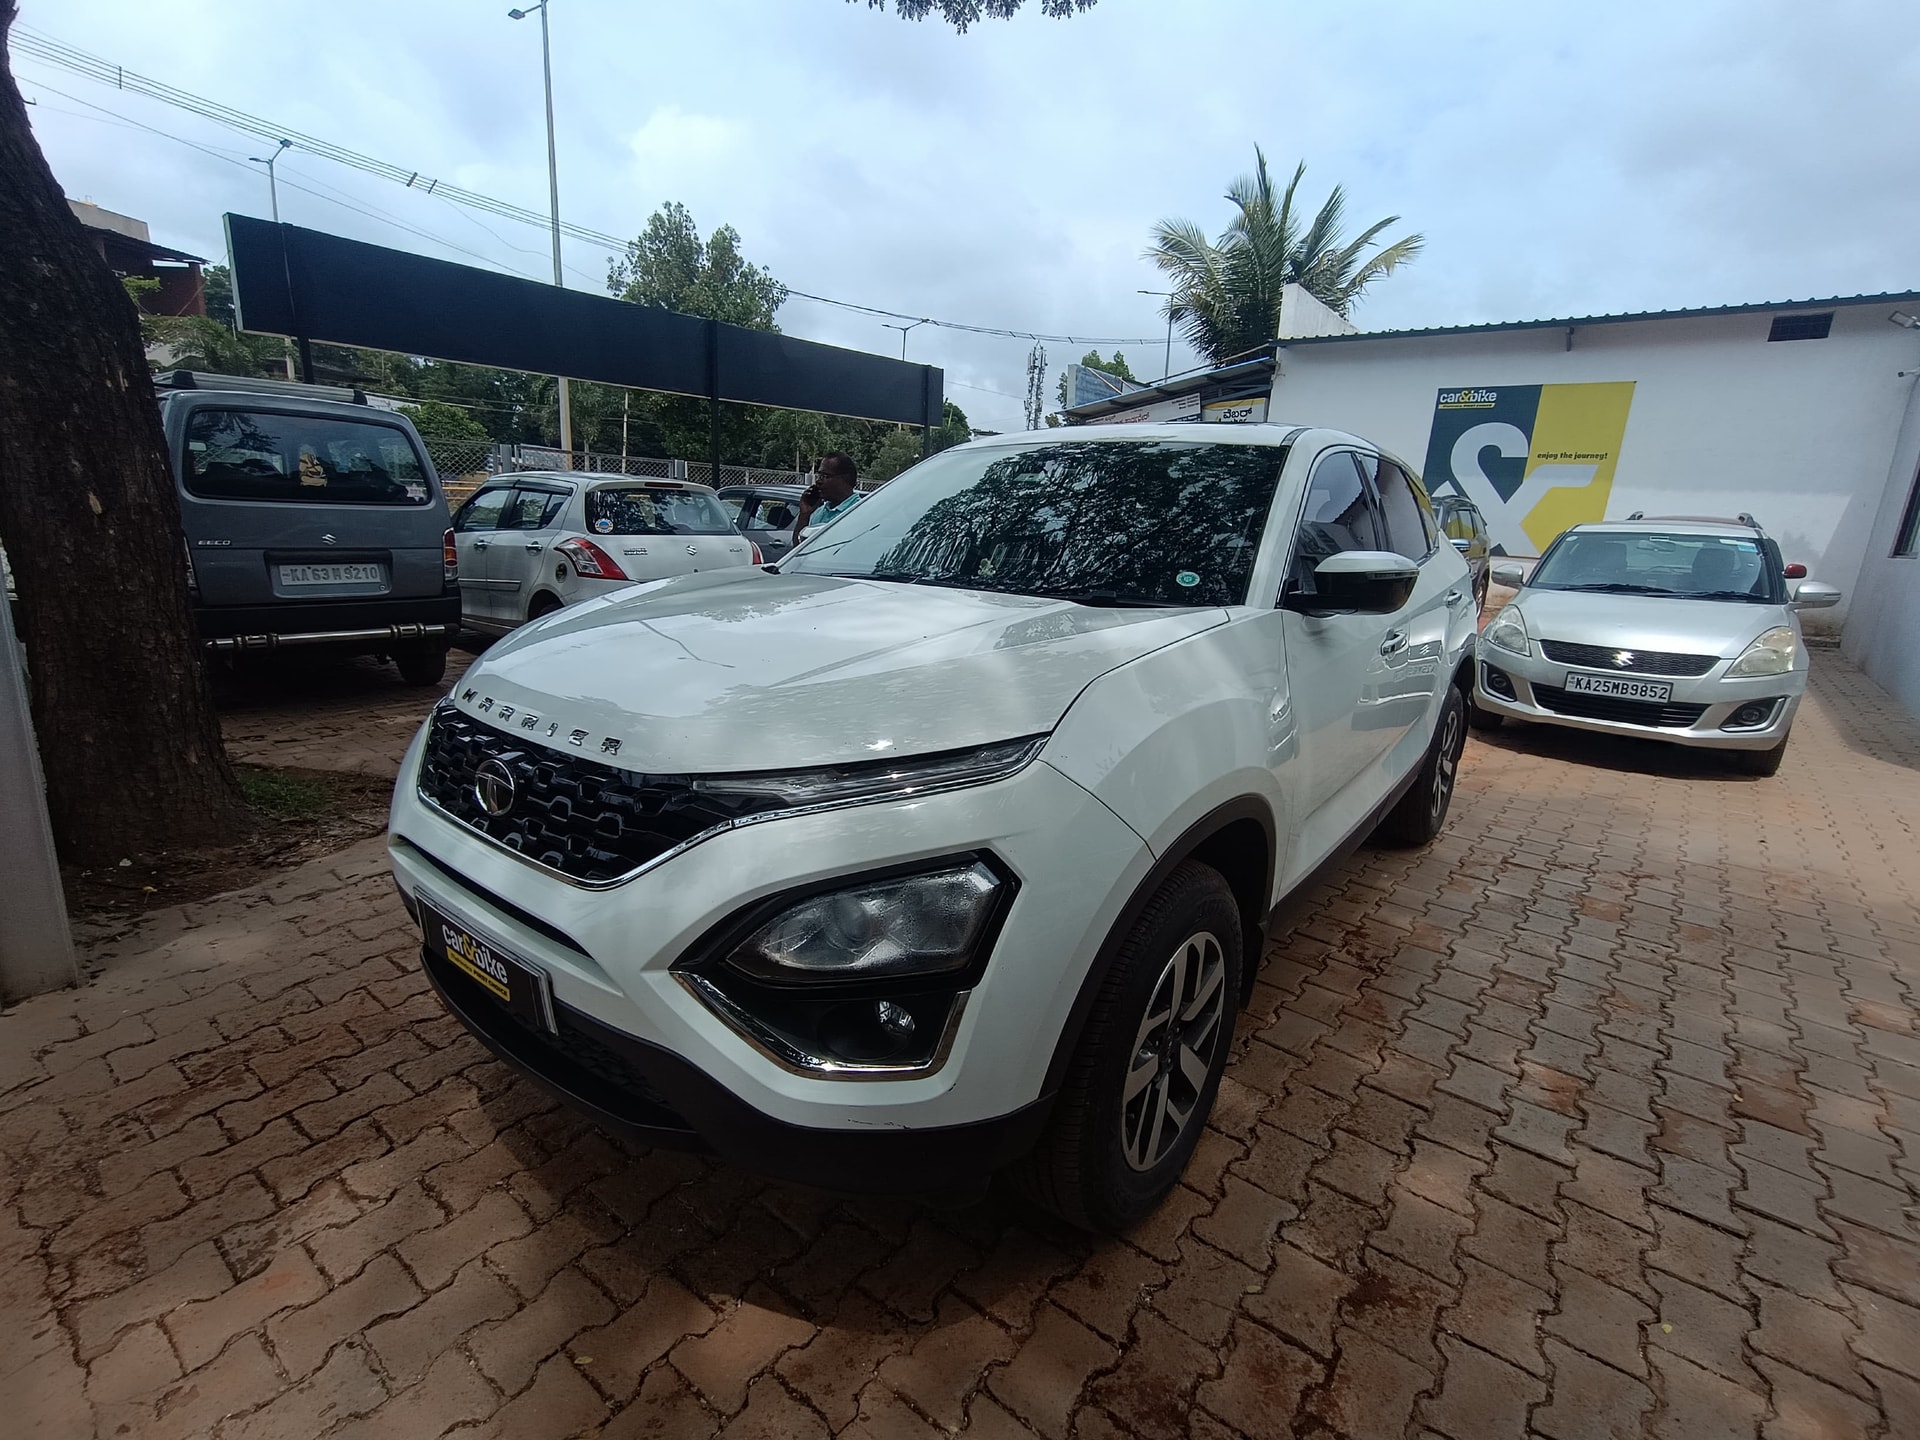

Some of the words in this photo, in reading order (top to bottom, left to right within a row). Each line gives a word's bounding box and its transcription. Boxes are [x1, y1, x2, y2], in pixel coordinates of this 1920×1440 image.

[1440, 389, 1497, 403] car&bike
[1537, 451, 1559, 460] enjoy
[1560, 451, 1573, 459] the
[1574, 451, 1608, 461] journey!
[1575, 676, 1669, 700] KA25MB9852
[462, 687, 623, 756] HARRIER
[442, 924, 508, 984] car&bike
